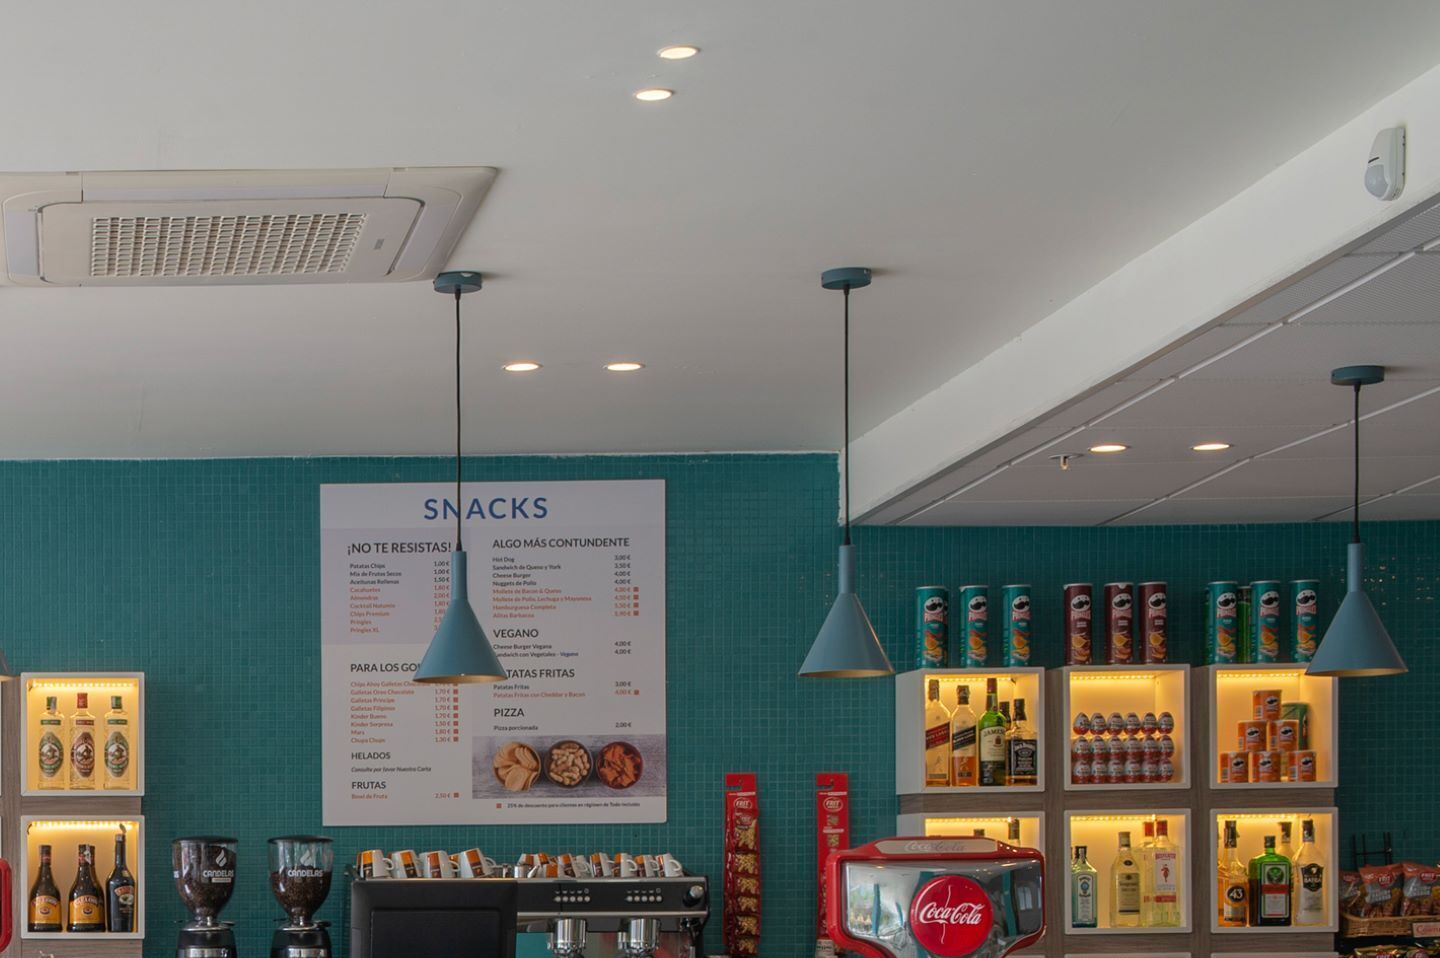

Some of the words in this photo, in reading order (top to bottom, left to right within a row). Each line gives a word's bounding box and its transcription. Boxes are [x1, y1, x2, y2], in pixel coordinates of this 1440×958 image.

[424, 497, 548, 520] SNACKS
[492, 538, 522, 549] ALGO
[523, 537, 547, 549] MÁS
[548, 537, 630, 548] CONTUNDENTE
[347, 543, 372, 556] ¡NO
[373, 543, 389, 554] TE
[391, 542, 452, 554] RESISTAS!
[492, 629, 539, 639] VEGANO
[350, 663, 378, 674] PARA
[379, 663, 399, 674] LOS
[538, 668, 575, 679] FRITAS
[493, 707, 525, 718] PIZZA
[351, 751, 391, 760] HELADOS
[351, 781, 387, 790] FRUTAS
[1229, 888, 1243, 900] 43
[919, 901, 986, 925] Coca-Cola
